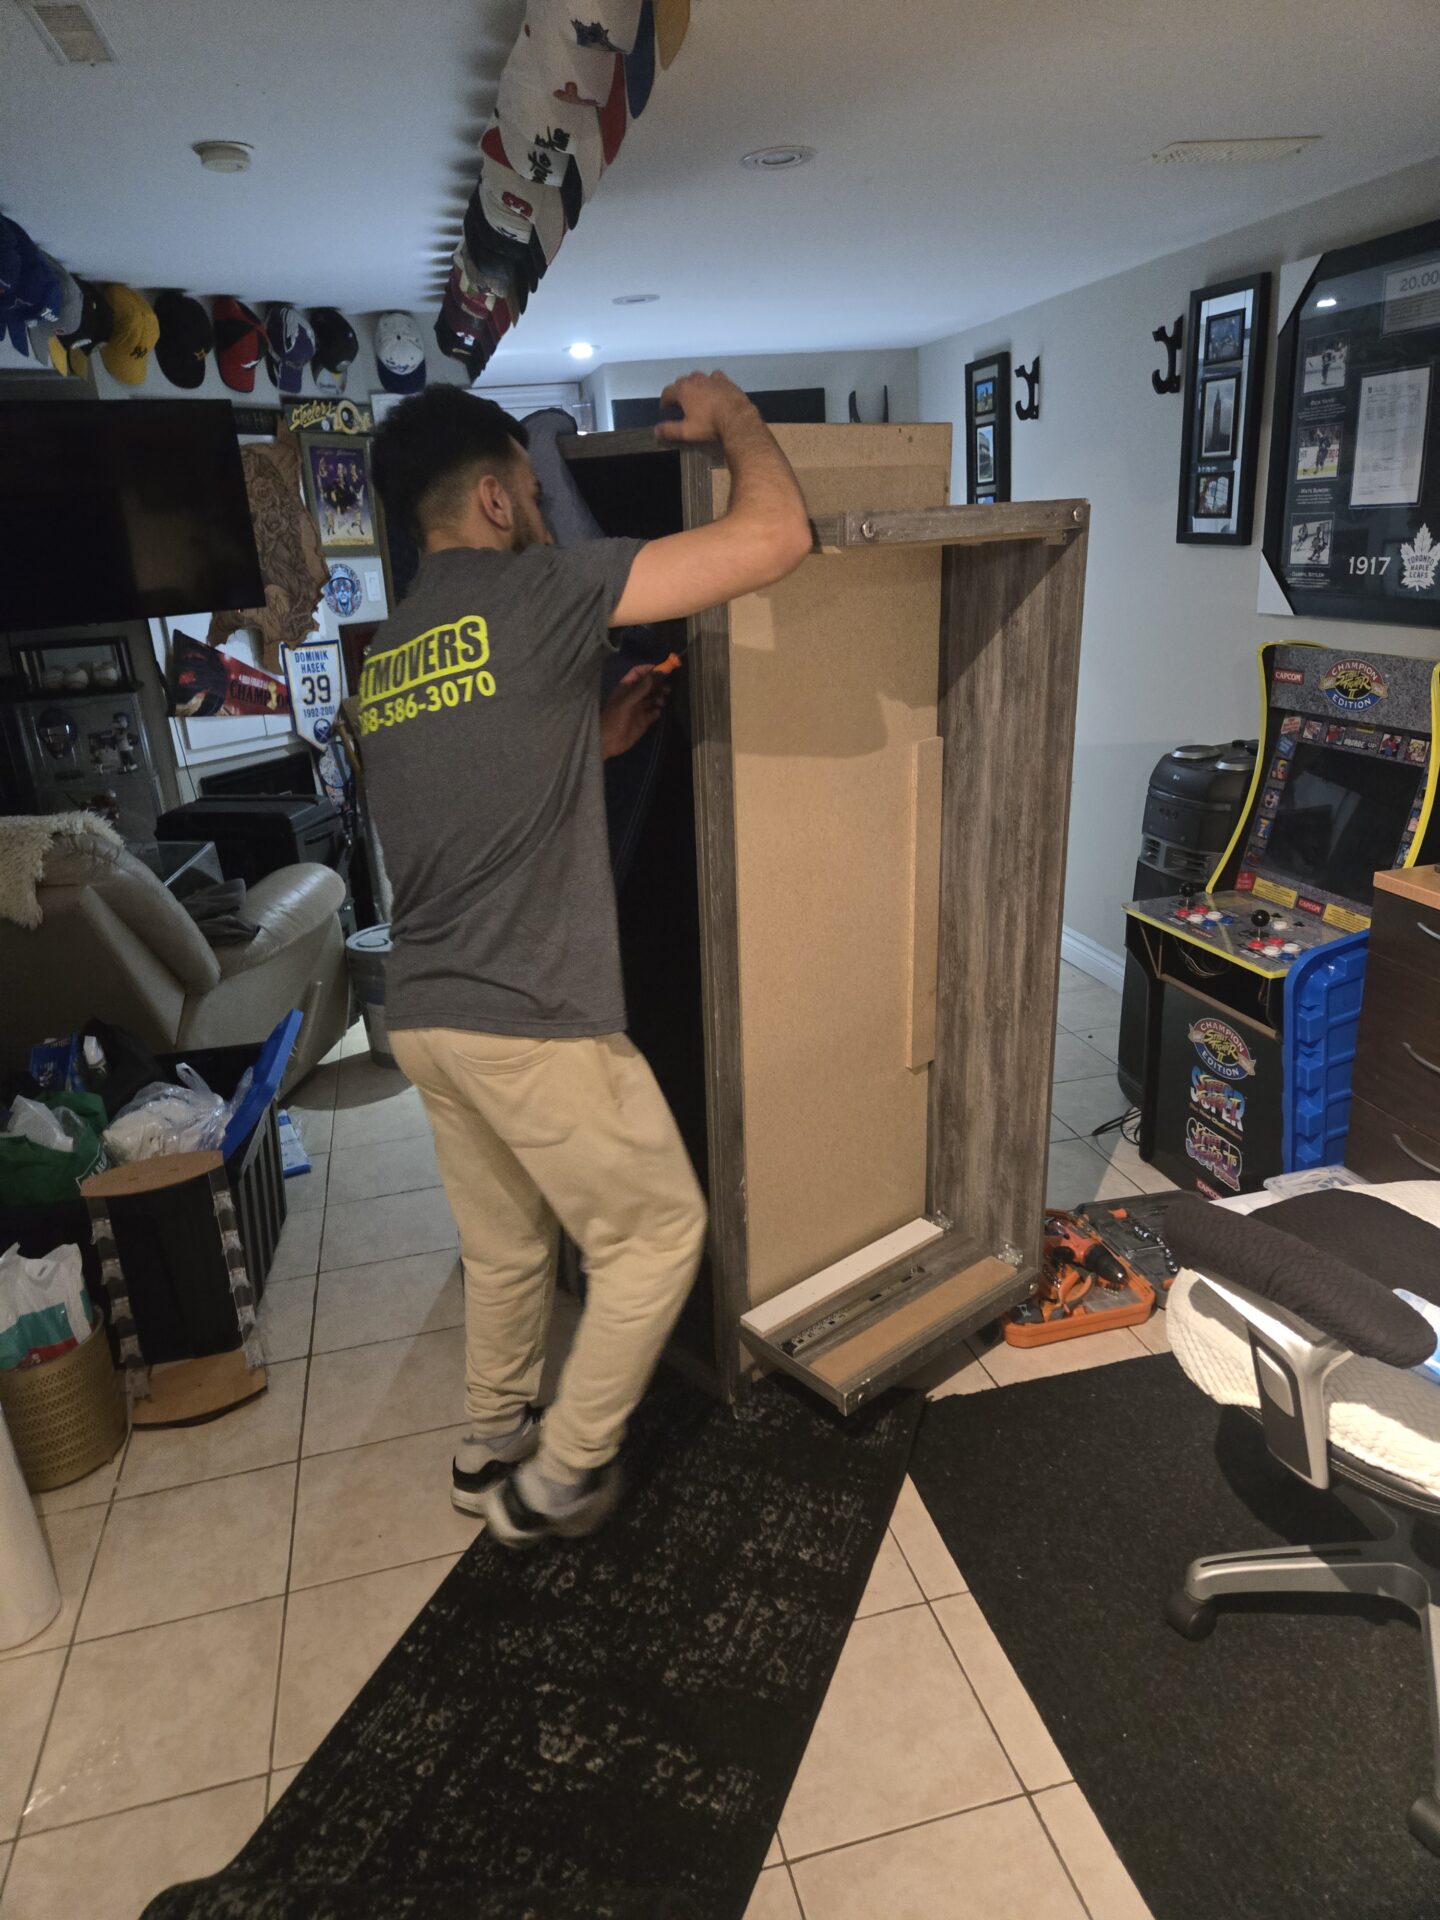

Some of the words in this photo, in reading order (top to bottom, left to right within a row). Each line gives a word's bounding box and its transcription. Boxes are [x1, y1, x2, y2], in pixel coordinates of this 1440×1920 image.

[1349, 555, 1391, 575] 1917
[1407, 554, 1434, 566] TORONTO
[294, 650, 329, 663] DOMINIK
[301, 662, 327, 674] HASEK
[1331, 661, 1378, 681] CHAMPION
[1275, 671, 1302, 682] CAPCOM
[302, 674, 331, 706] 39
[1332, 693, 1371, 709] EDITION
[303, 706, 335, 718] 1992-2001
[1298, 900, 1321, 913] CAPCOM
[1200, 1021, 1244, 1052] CHAMPION
[1202, 1050, 1239, 1076] EDITION
